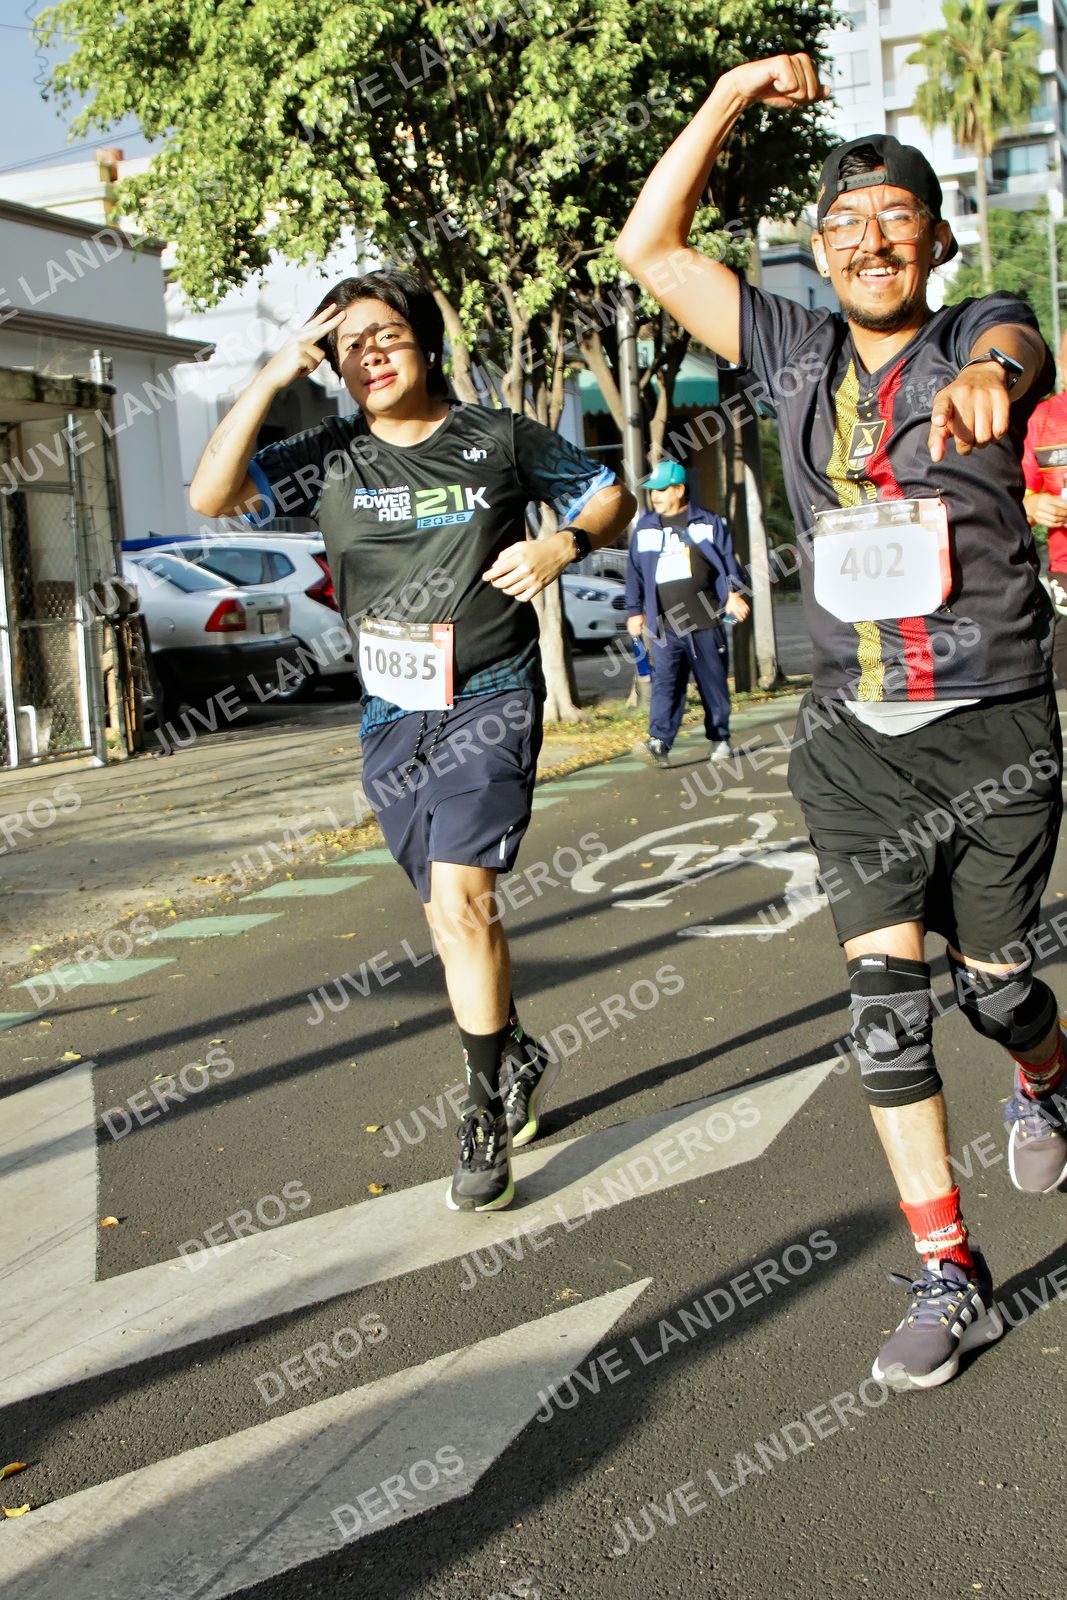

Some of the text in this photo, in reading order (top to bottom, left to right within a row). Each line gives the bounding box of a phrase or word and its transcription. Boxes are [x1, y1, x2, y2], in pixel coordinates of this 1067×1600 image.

[353, 492, 411, 509] POWER
[414, 484, 491, 518] 21K
[378, 505, 413, 522] ADE
[422, 513, 466, 527] 2026
[840, 542, 905, 582] 402
[364, 645, 437, 681] 10835
